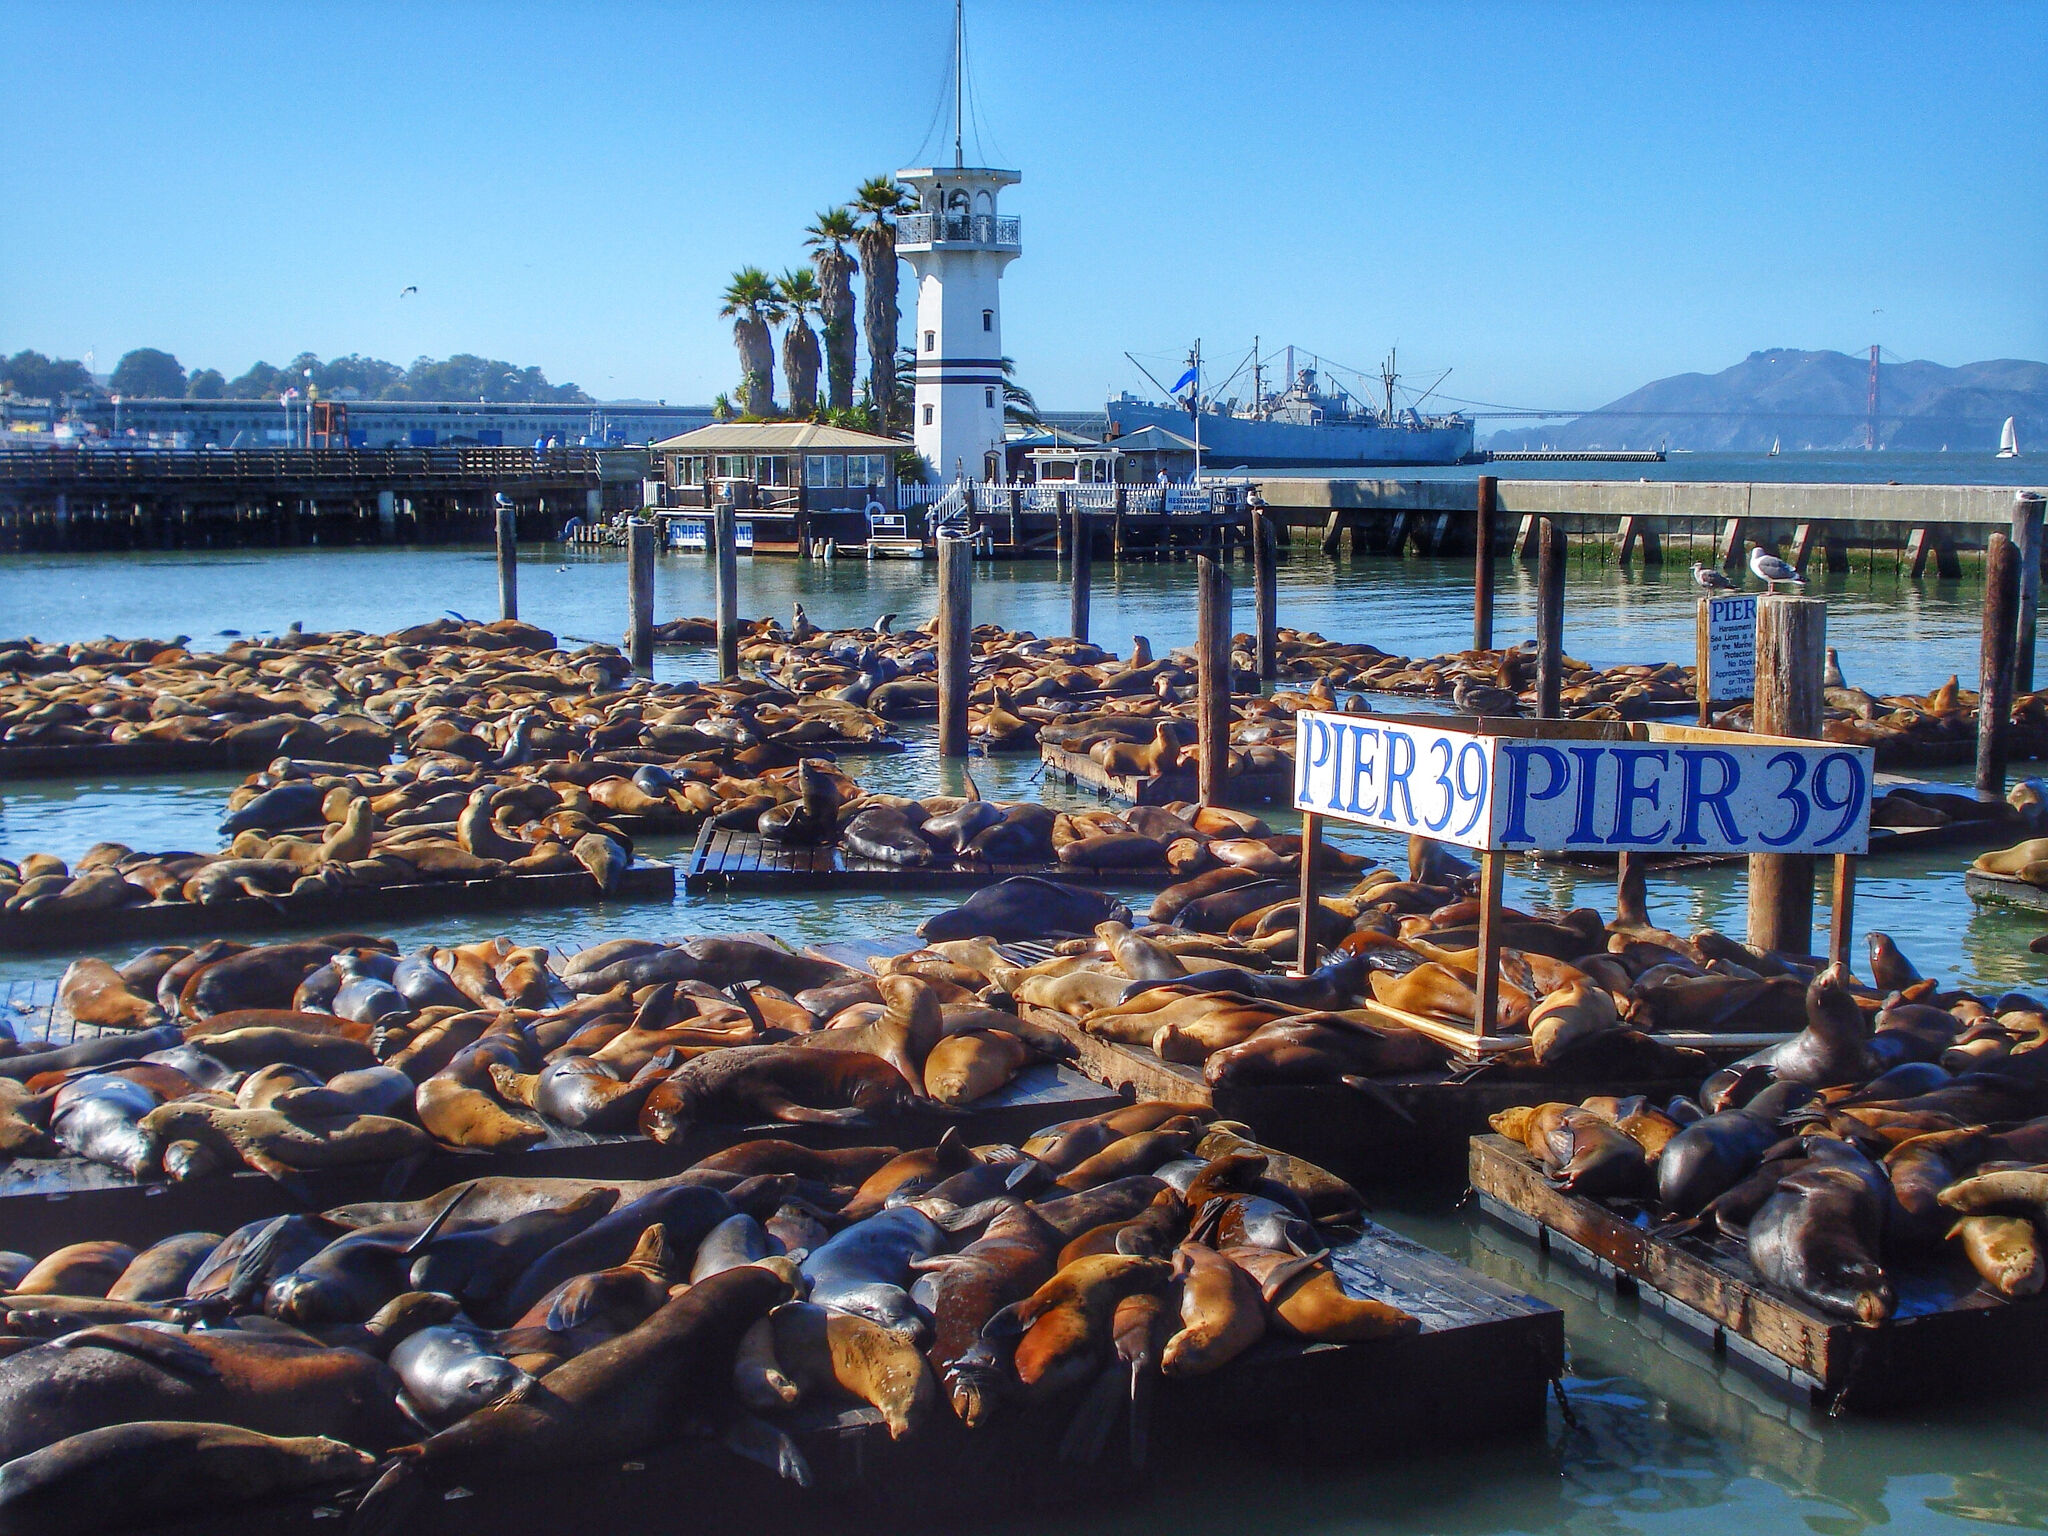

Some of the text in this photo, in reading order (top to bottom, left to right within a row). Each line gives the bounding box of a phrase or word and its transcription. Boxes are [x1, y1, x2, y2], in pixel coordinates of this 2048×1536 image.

[670, 525, 706, 539] FORBES
[1712, 599, 1756, 622] PIER
[1710, 635, 1722, 643] Sea
[1724, 633, 1740, 641] Lions
[1724, 650, 1753, 659] Protection
[1728, 660, 1737, 668] No
[1721, 686, 1744, 695] Objects
[1299, 717, 1488, 838] PIER 39
[1498, 743, 1866, 848] PIER 39
